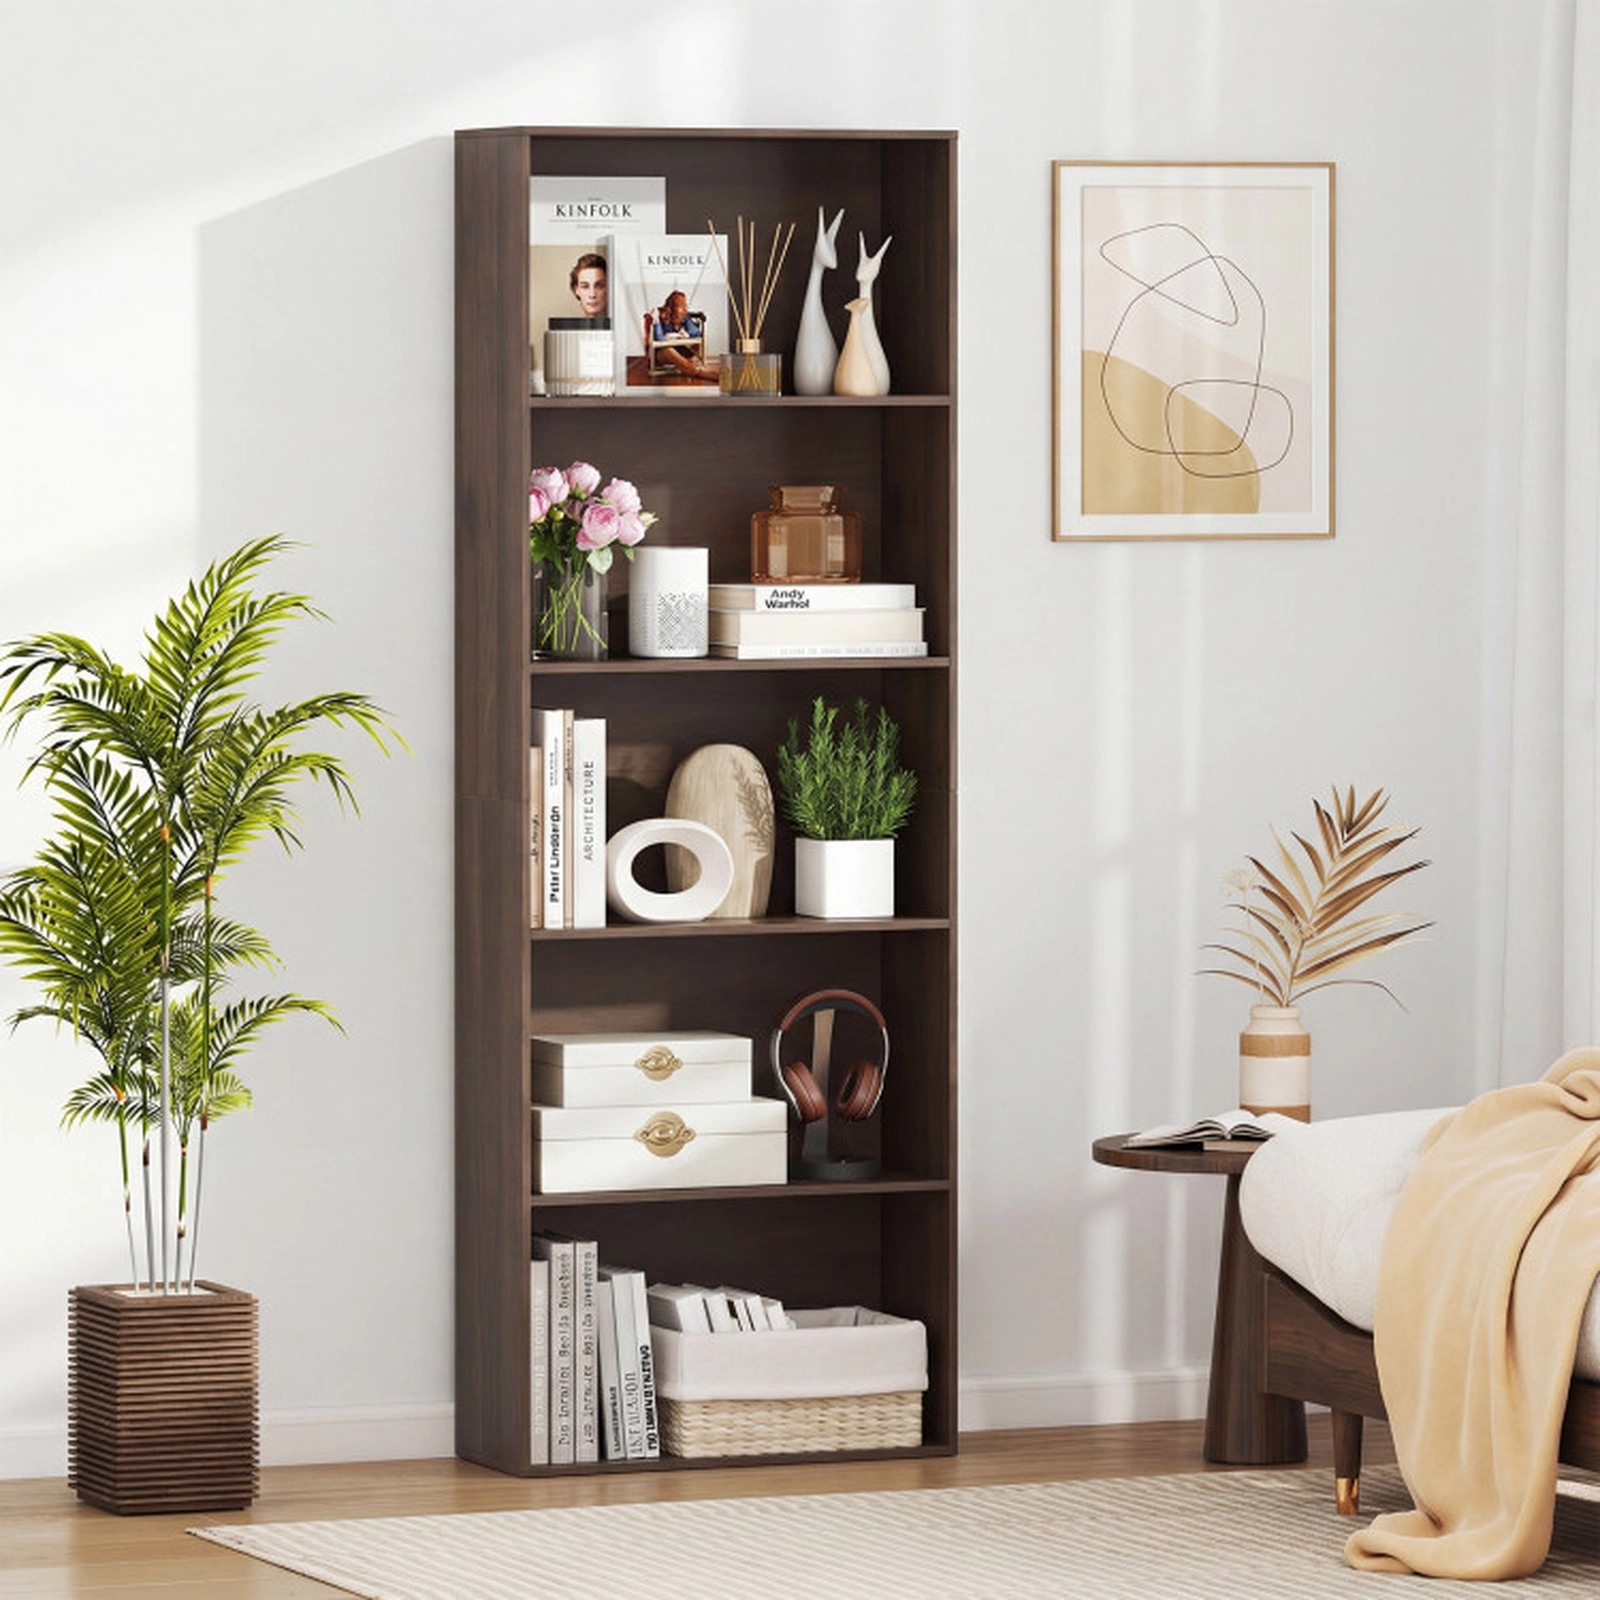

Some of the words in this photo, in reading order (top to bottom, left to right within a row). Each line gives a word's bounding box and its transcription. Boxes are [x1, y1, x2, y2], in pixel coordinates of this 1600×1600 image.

[555, 204, 632, 218] KINFOLK
[647, 255, 705, 266] KINFOLK
[770, 588, 805, 601] Andy
[764, 598, 810, 610] Warhol
[583, 761, 594, 861] ARCHITECTURE
